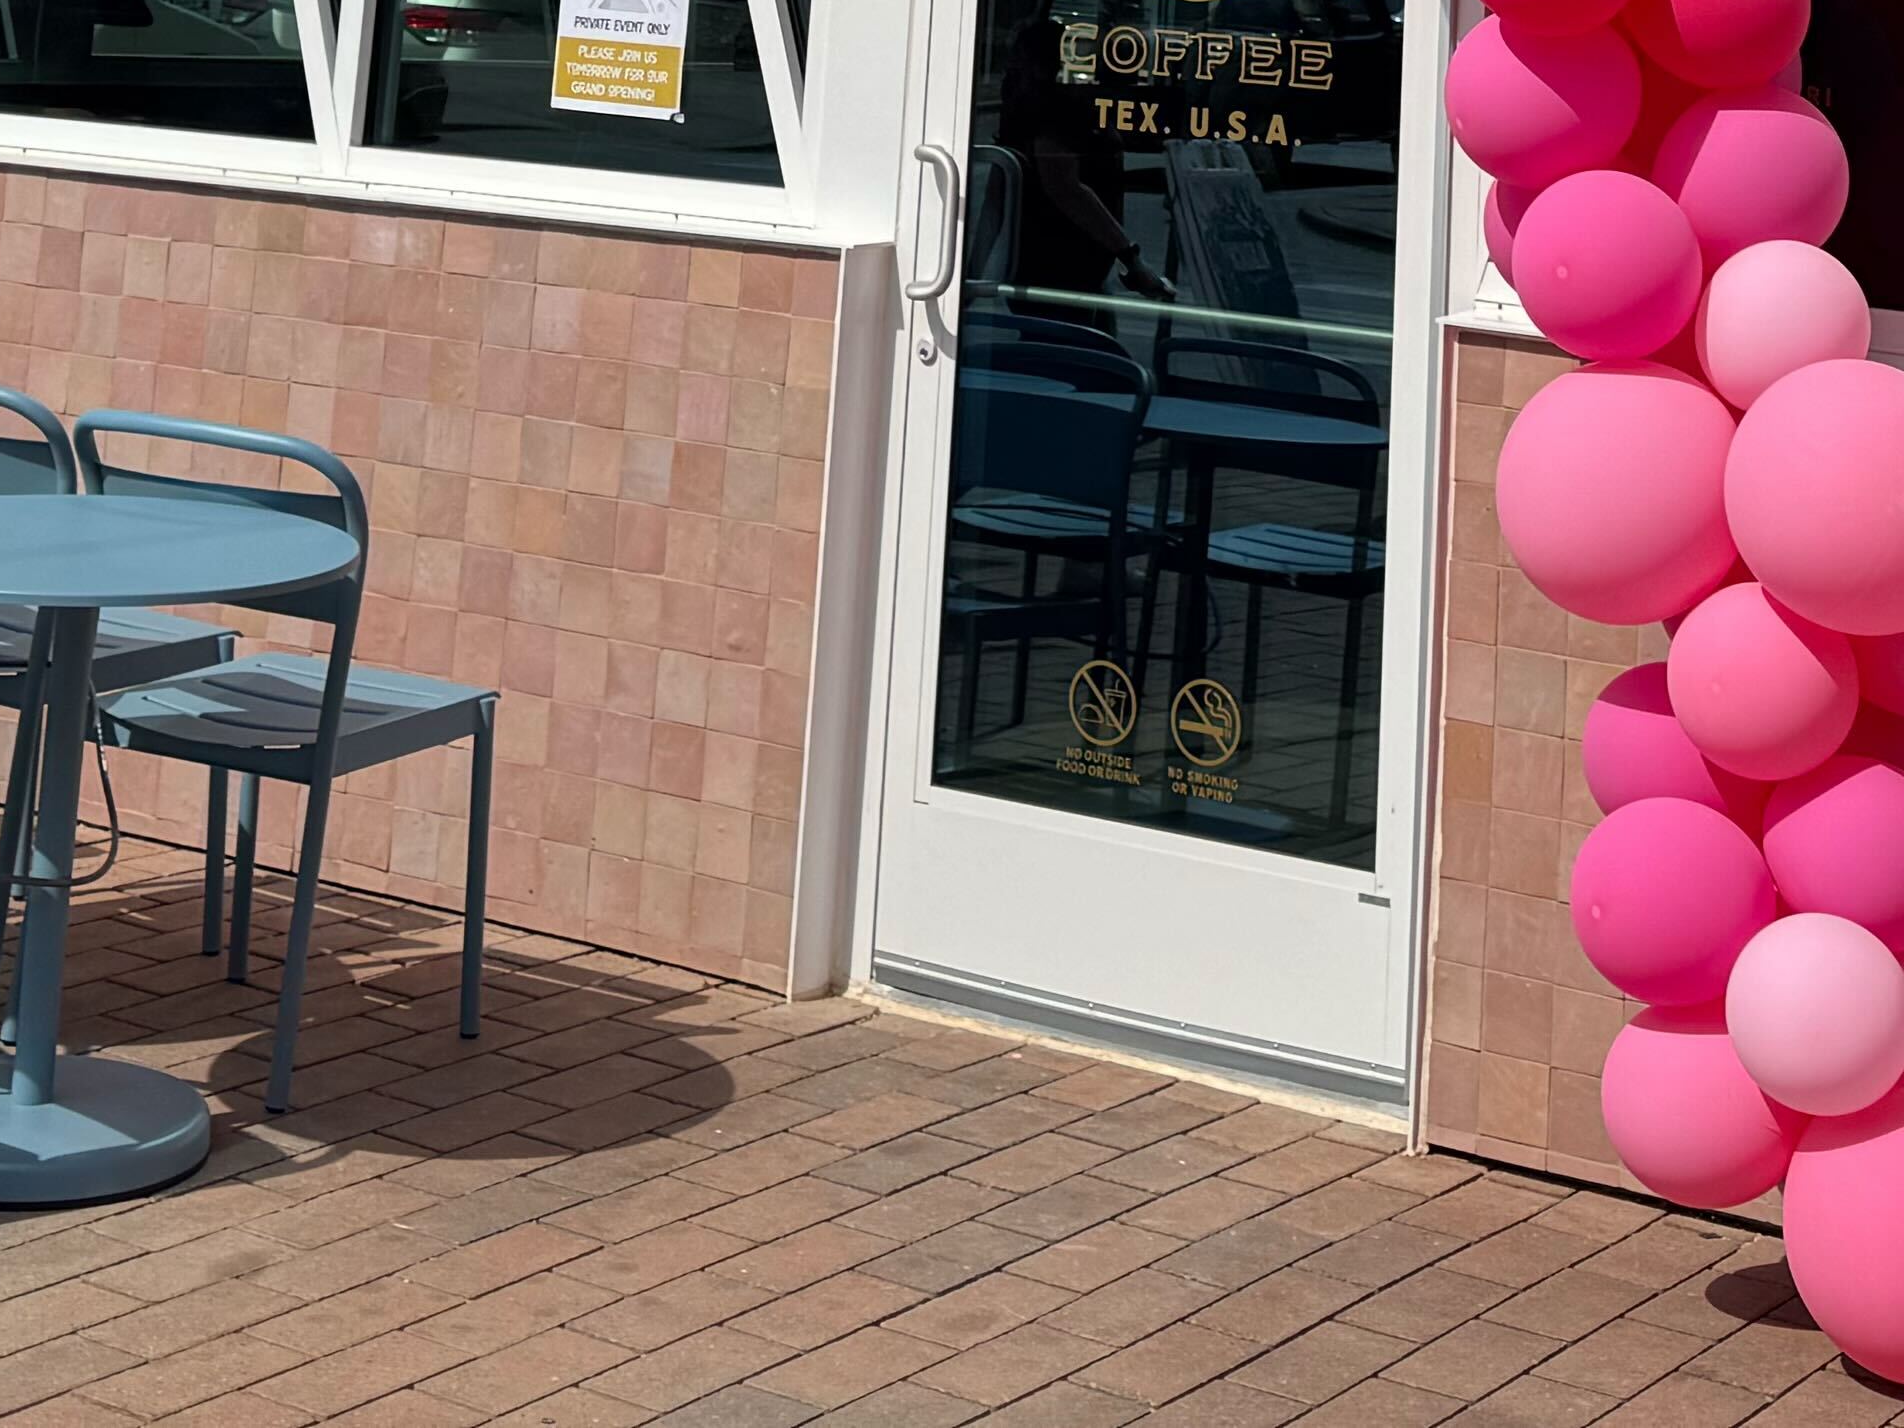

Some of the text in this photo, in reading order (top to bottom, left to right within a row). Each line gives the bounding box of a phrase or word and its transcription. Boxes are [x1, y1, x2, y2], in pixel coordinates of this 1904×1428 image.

[574, 15, 671, 35] PRIVATE EVENT ONLY
[578, 44, 657, 64] PLEASE JOIN US
[1059, 23, 1333, 90] COFFEE
[566, 61, 668, 84] TOMORROW FOR OUR
[571, 80, 606, 96] GRAND
[1095, 98, 1302, 147] TEX. U.S.A.
[1066, 746, 1132, 769] NO OUTSIDE
[1056, 758, 1141, 785] FOOD OR DRINK
[1168, 766, 1238, 790] NO SMOKING
[1171, 781, 1232, 803] OR VAPING
